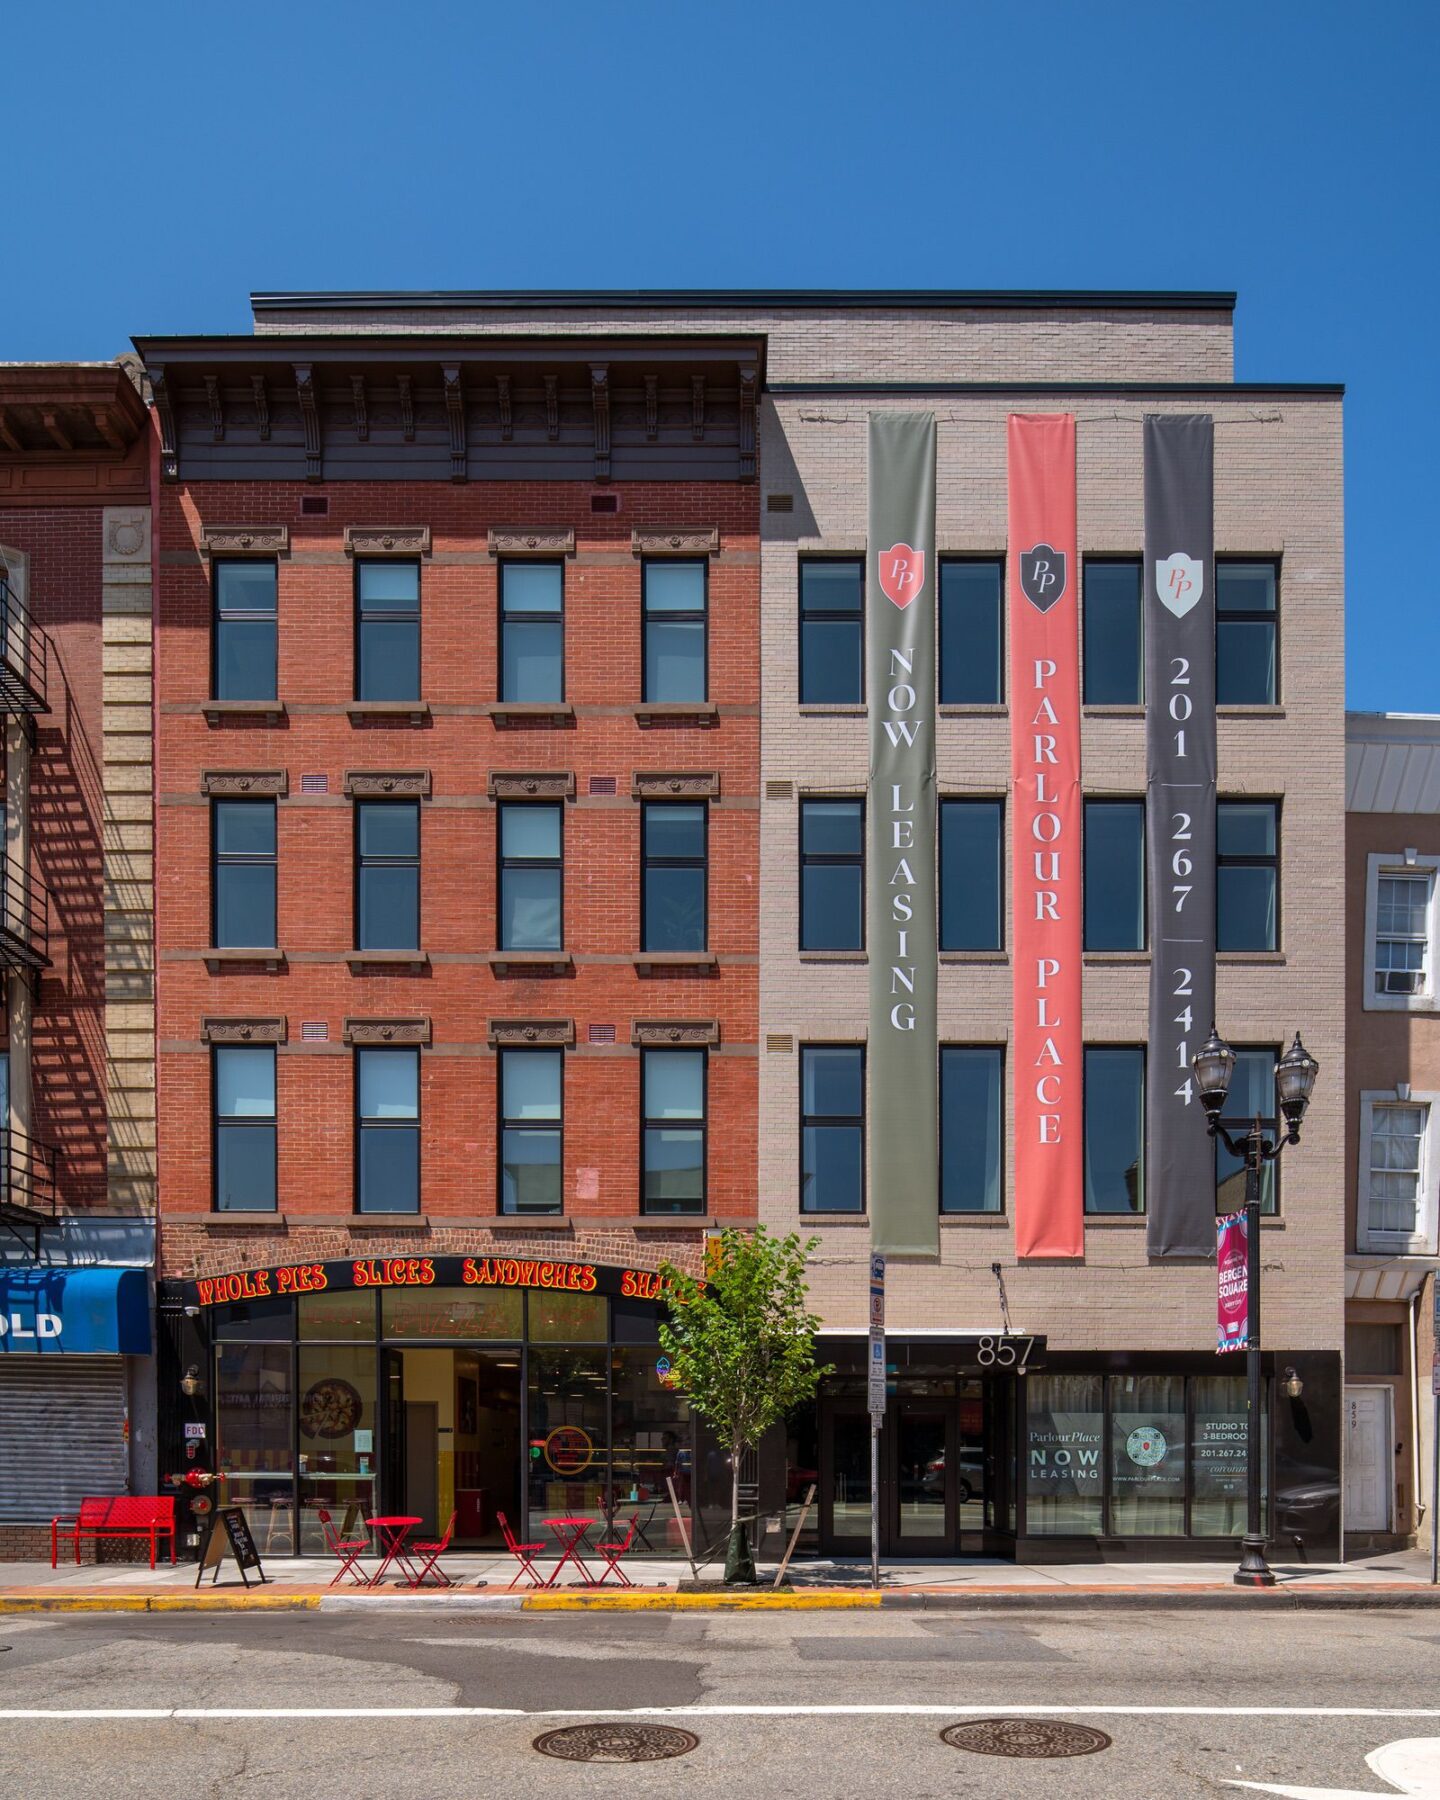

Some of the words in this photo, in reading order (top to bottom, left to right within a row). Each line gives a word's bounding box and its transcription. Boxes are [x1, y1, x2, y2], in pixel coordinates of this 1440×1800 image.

[881, 648, 924, 748] NOW
[1169, 657, 1193, 757] 201
[1031, 660, 1062, 921] PARLOUR
[1172, 813, 1193, 913] 267
[888, 784, 917, 1031] LEASING
[1034, 960, 1064, 1144] PLACE
[1173, 968, 1194, 1106] 2414
[196, 1271, 271, 1305] WHOLE
[276, 1264, 328, 1293] PIES
[353, 1259, 435, 1286] SLICES
[462, 1258, 597, 1291] SANDWICHES
[1219, 1265, 1248, 1285] BERGEN
[1219, 1279, 1248, 1299] SQUARE
[394, 1302, 508, 1334] PIZZA
[977, 1336, 1035, 1366] 857
[1029, 1432, 1071, 1443] Parlour
[1072, 1432, 1100, 1443] Place
[1031, 1450, 1099, 1466] NOW
[1031, 1469, 1098, 1479] LEASING
